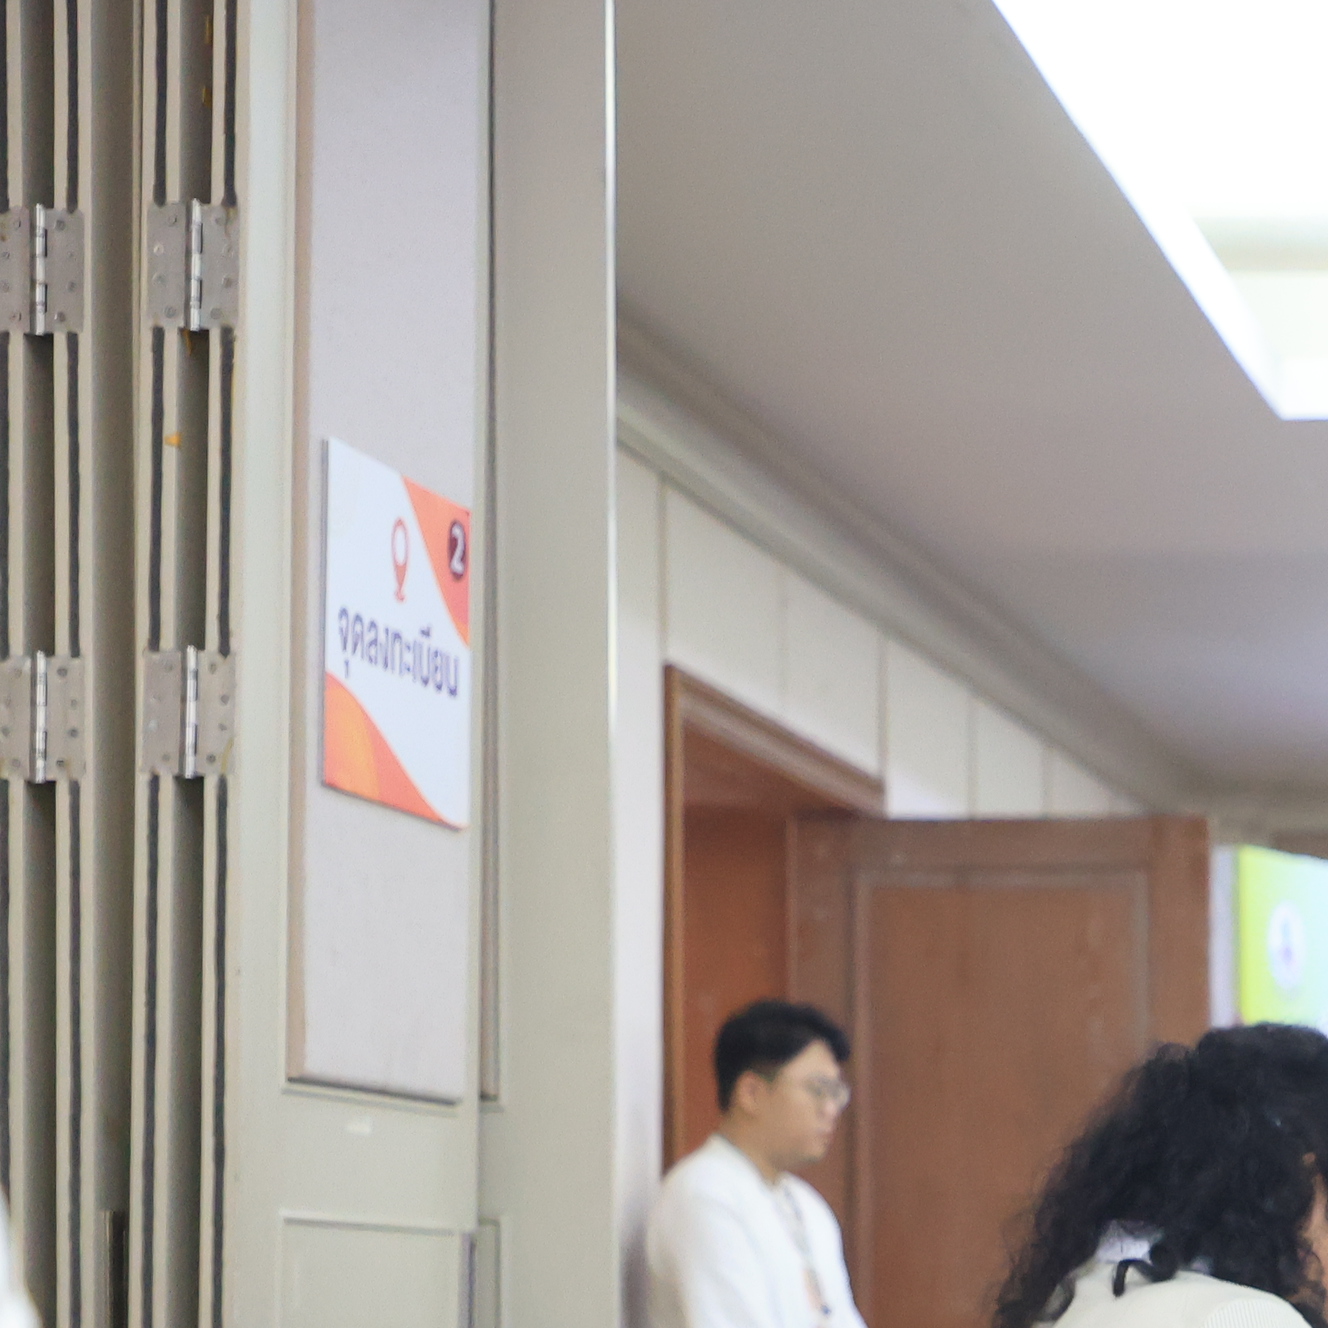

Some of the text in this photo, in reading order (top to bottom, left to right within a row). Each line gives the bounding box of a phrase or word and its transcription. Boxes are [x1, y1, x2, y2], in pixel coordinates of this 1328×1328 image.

[450, 525, 465, 576] 2
[338, 606, 458, 698] จุดลงทะเบียน
